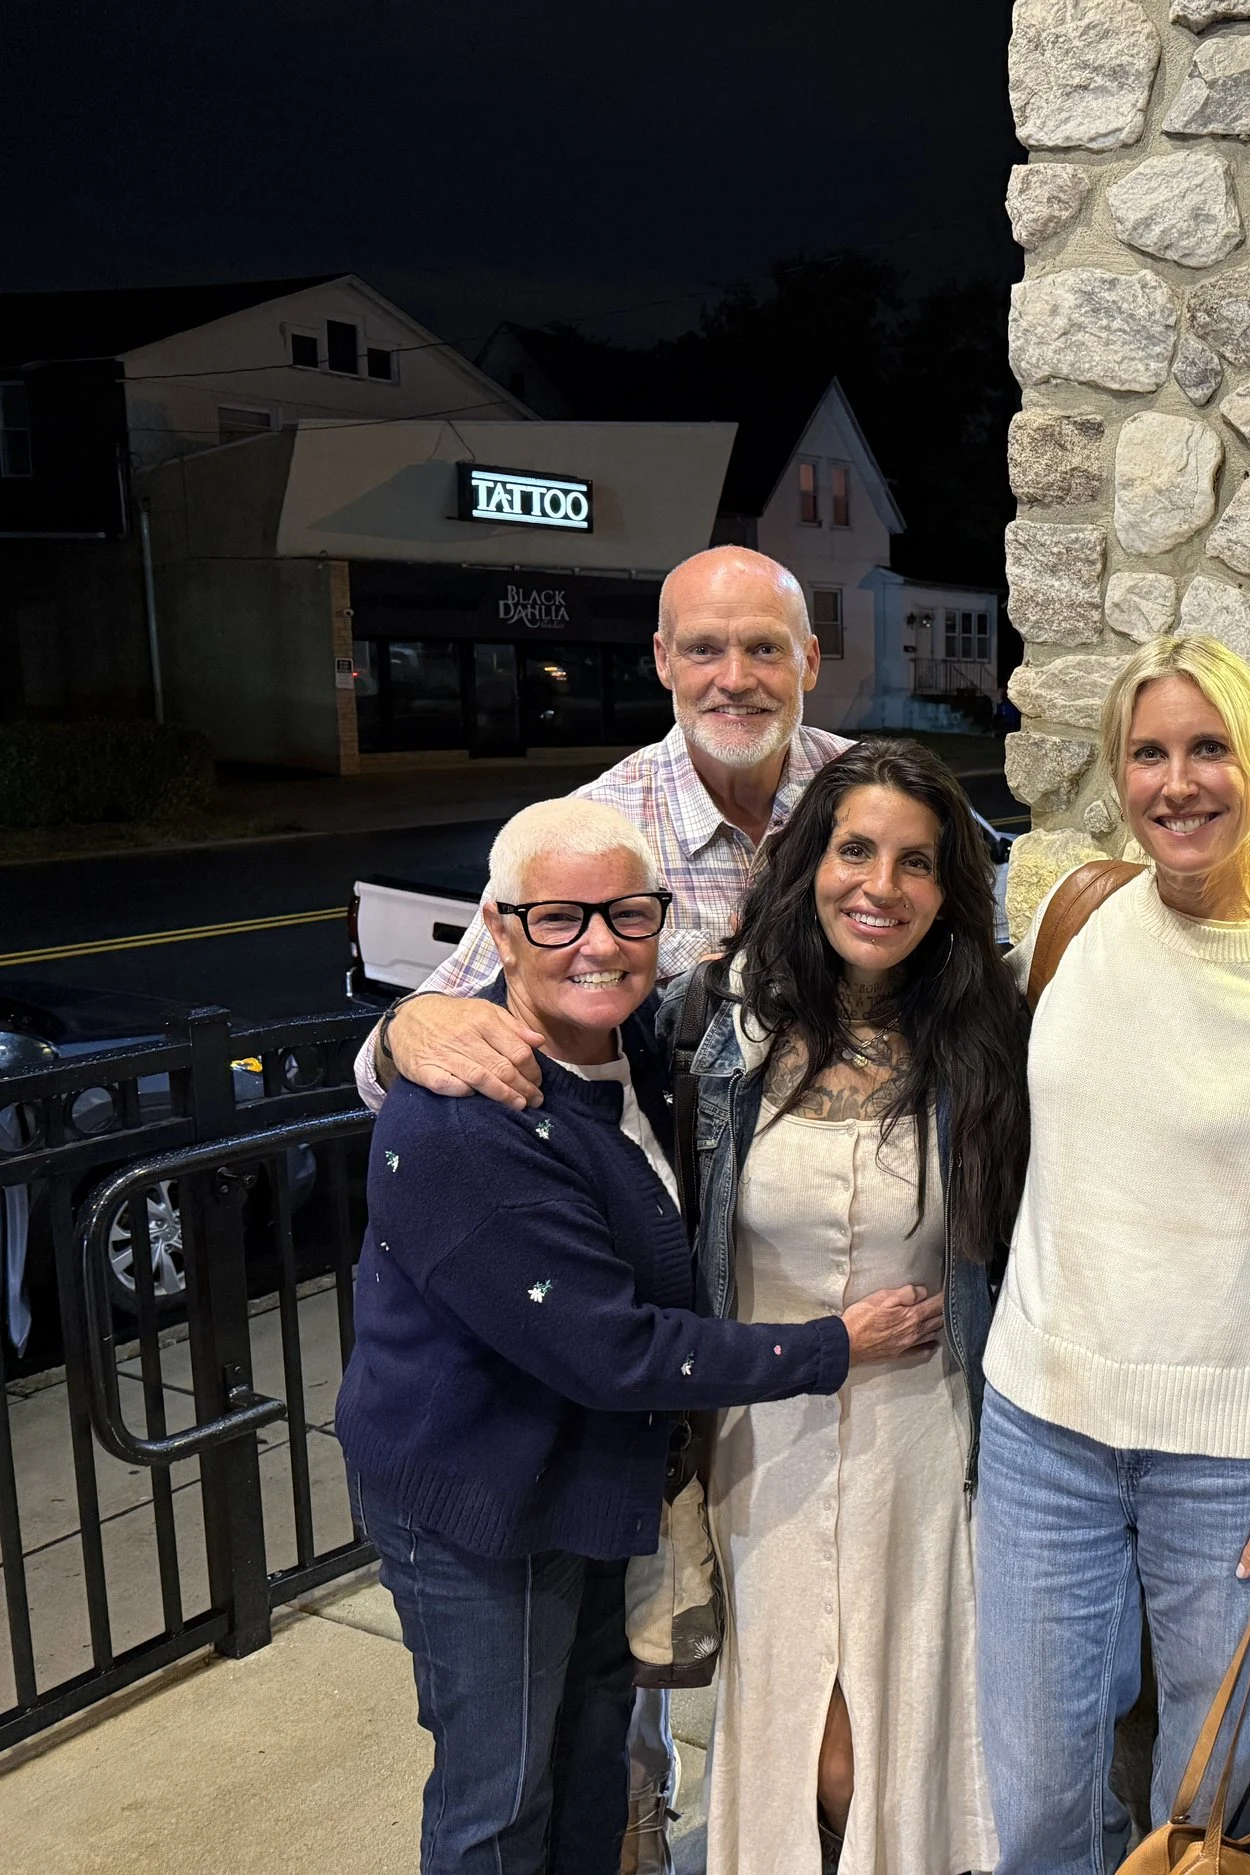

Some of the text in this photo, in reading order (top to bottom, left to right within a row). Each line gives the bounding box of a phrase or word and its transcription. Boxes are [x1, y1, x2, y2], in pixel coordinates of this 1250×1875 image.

[472, 479, 588, 521] TATTOO
[507, 585, 567, 605] BLACK
[499, 600, 570, 628] DAHLIA
